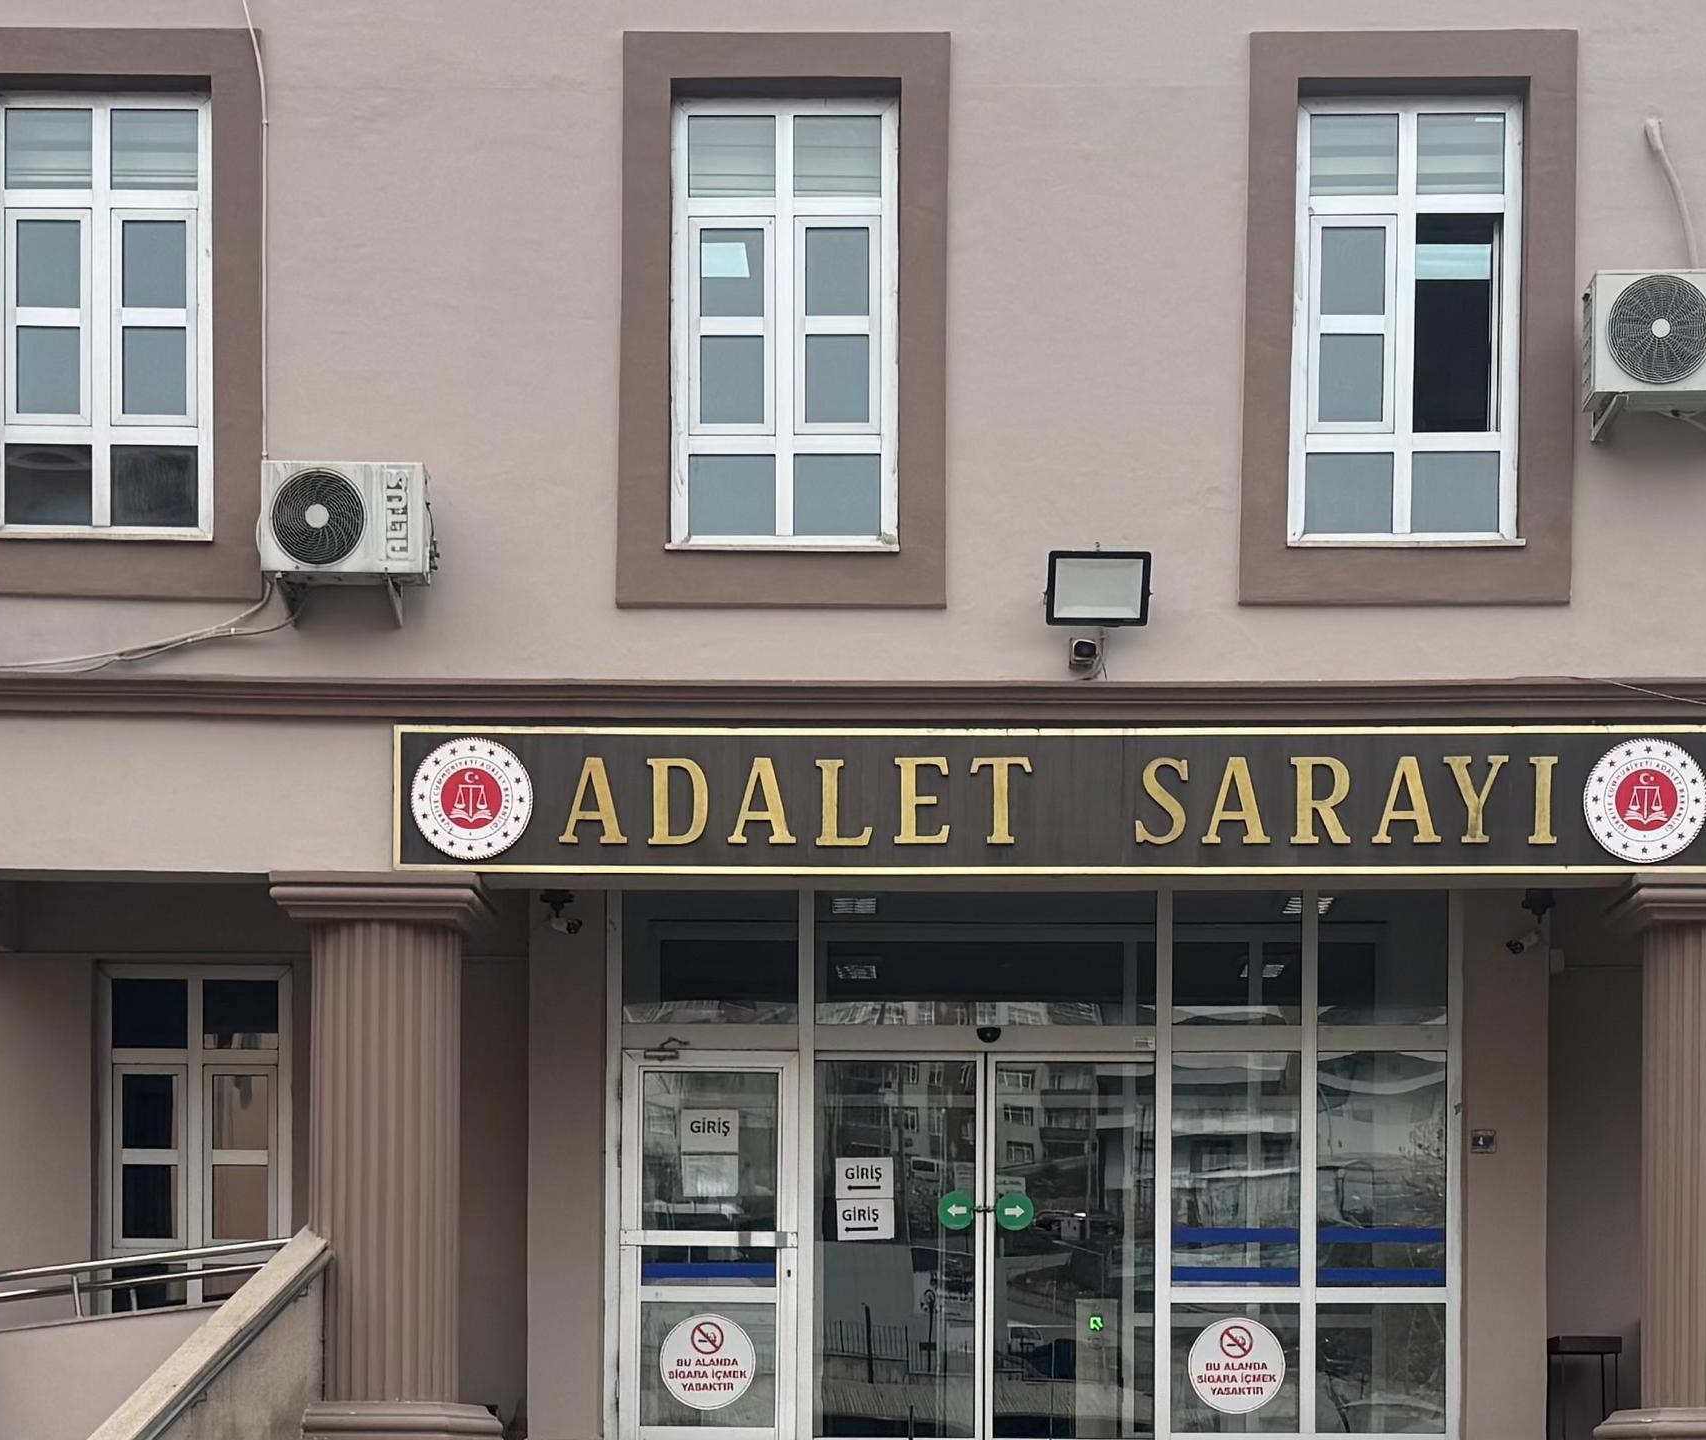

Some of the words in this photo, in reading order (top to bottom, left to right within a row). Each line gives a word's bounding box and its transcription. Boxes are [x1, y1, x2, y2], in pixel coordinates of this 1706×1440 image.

[558, 756, 1033, 846] ADALET
[1135, 755, 1559, 846] SARAYI
[690, 1117, 730, 1136] GİRİŞ
[845, 1165, 882, 1182] GİRİŞ
[842, 1206, 879, 1222] GİRİŞ
[695, 1358, 739, 1367] ALANDA
[1224, 1362, 1268, 1371] ALANDA
[711, 1369, 747, 1380] İÇMEK
[1241, 1373, 1277, 1385] İÇMEK
